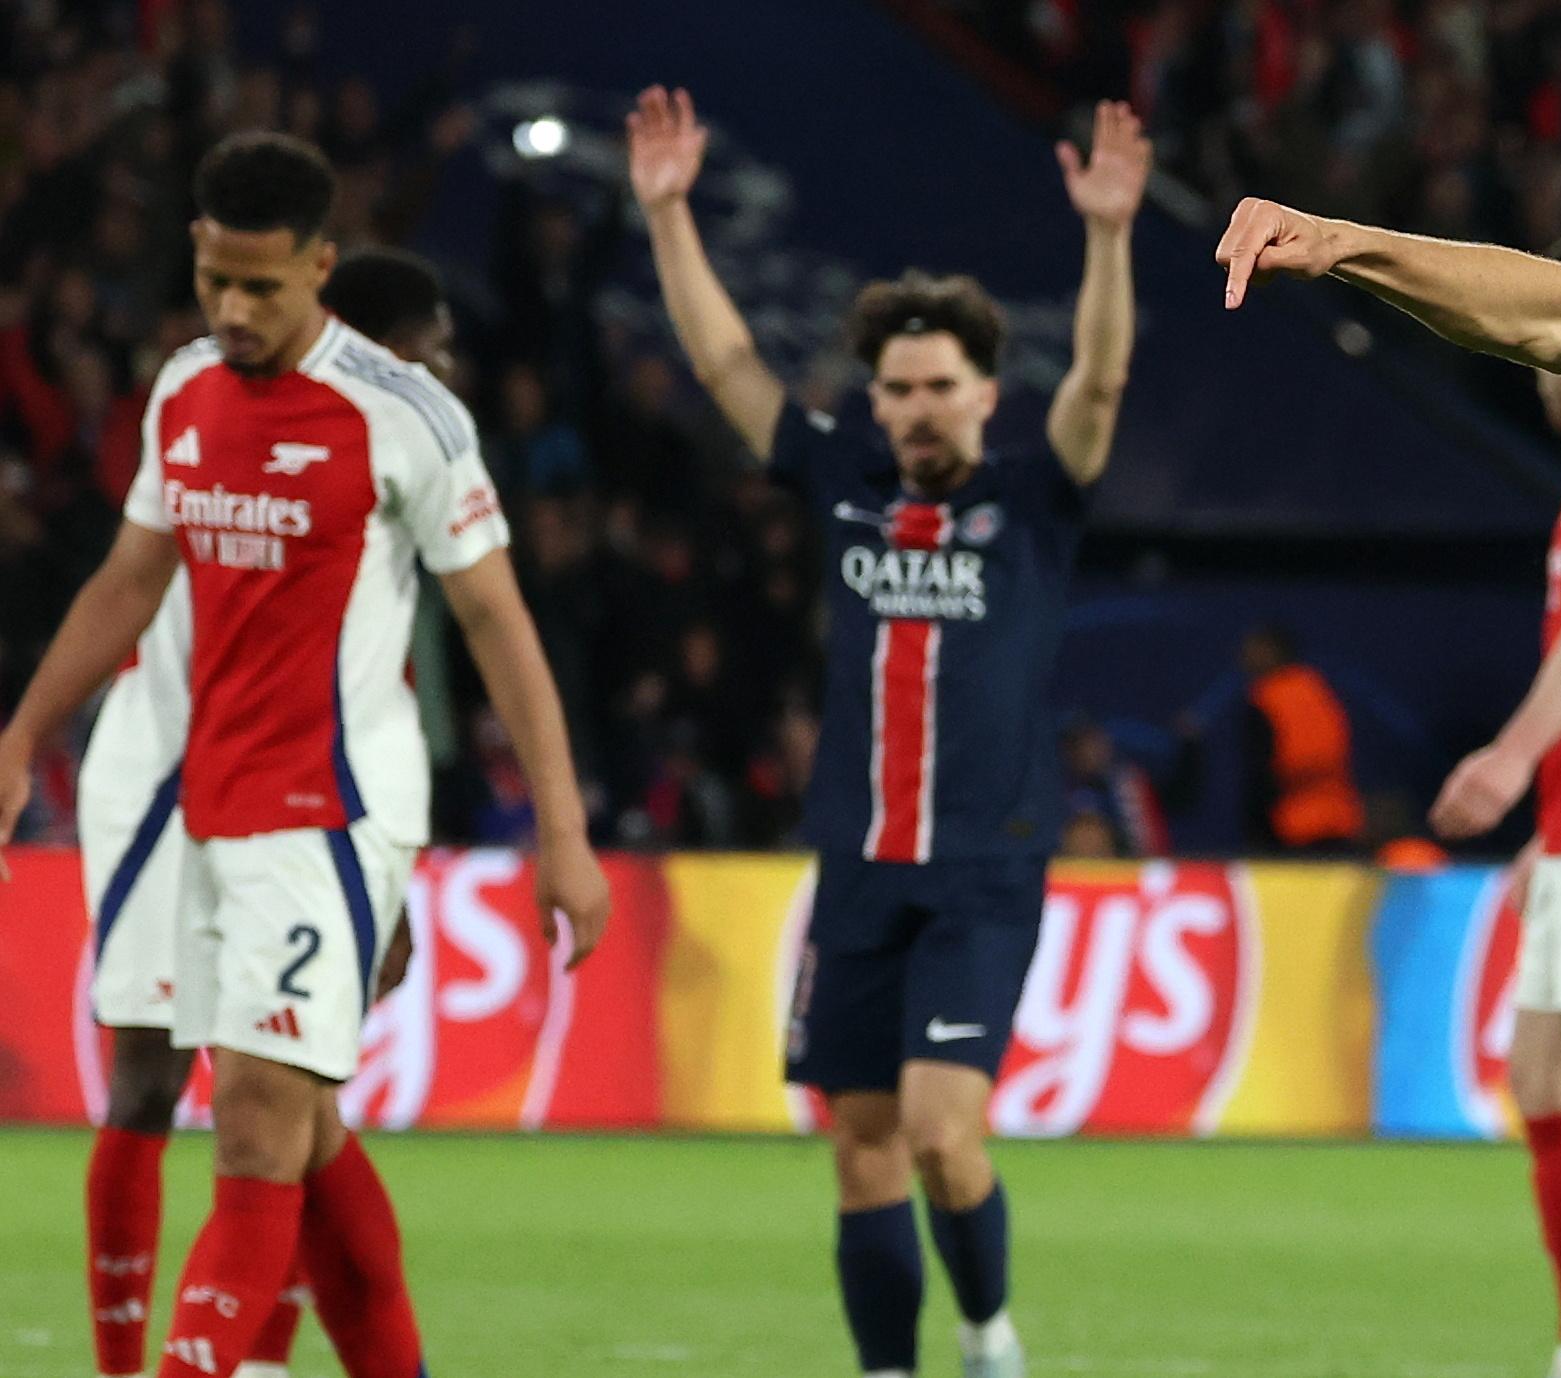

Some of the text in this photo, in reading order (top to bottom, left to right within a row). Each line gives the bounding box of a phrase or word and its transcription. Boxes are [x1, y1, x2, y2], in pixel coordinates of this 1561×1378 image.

[165, 479, 312, 537] Emirates
[840, 545, 985, 599] QATAR
[276, 921, 322, 1000] 2
